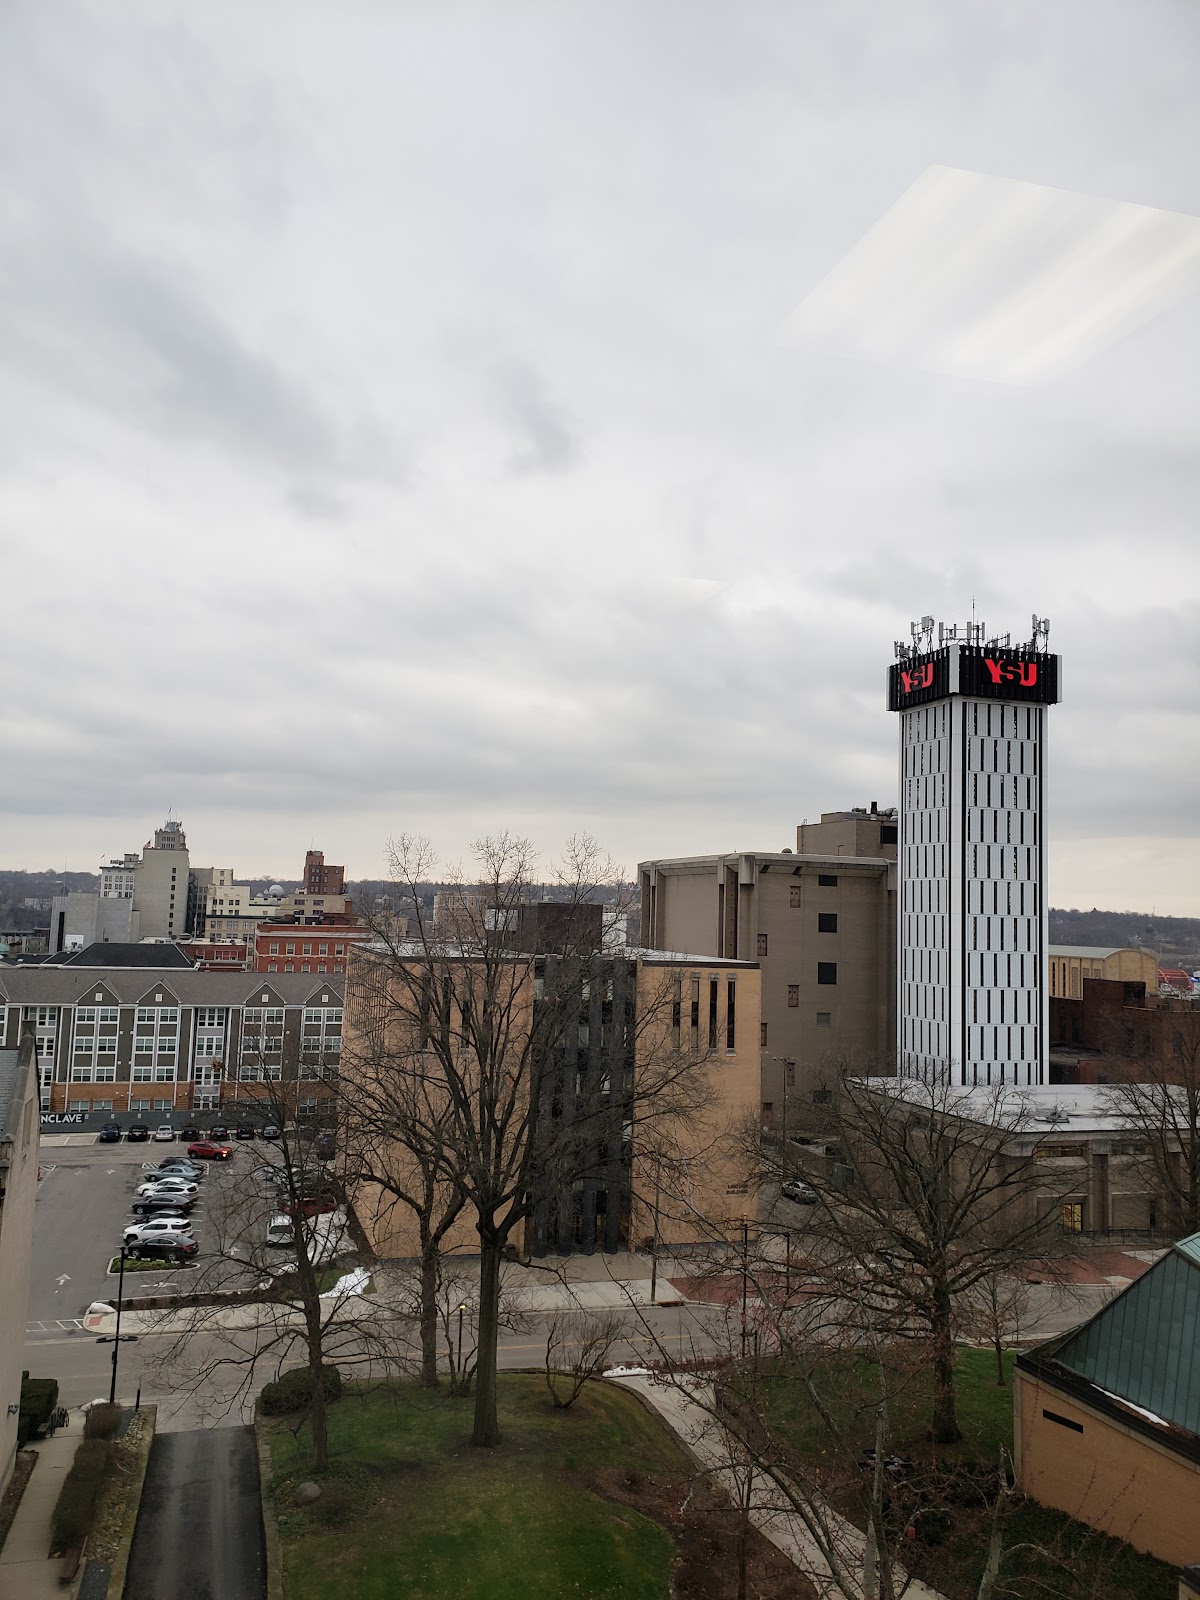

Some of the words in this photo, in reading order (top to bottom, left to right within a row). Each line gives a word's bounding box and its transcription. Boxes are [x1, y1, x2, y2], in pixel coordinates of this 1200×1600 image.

[901, 662, 934, 693] YSU
[985, 659, 1037, 687] YSU
[40, 1114, 83, 1124] NCLAVE
